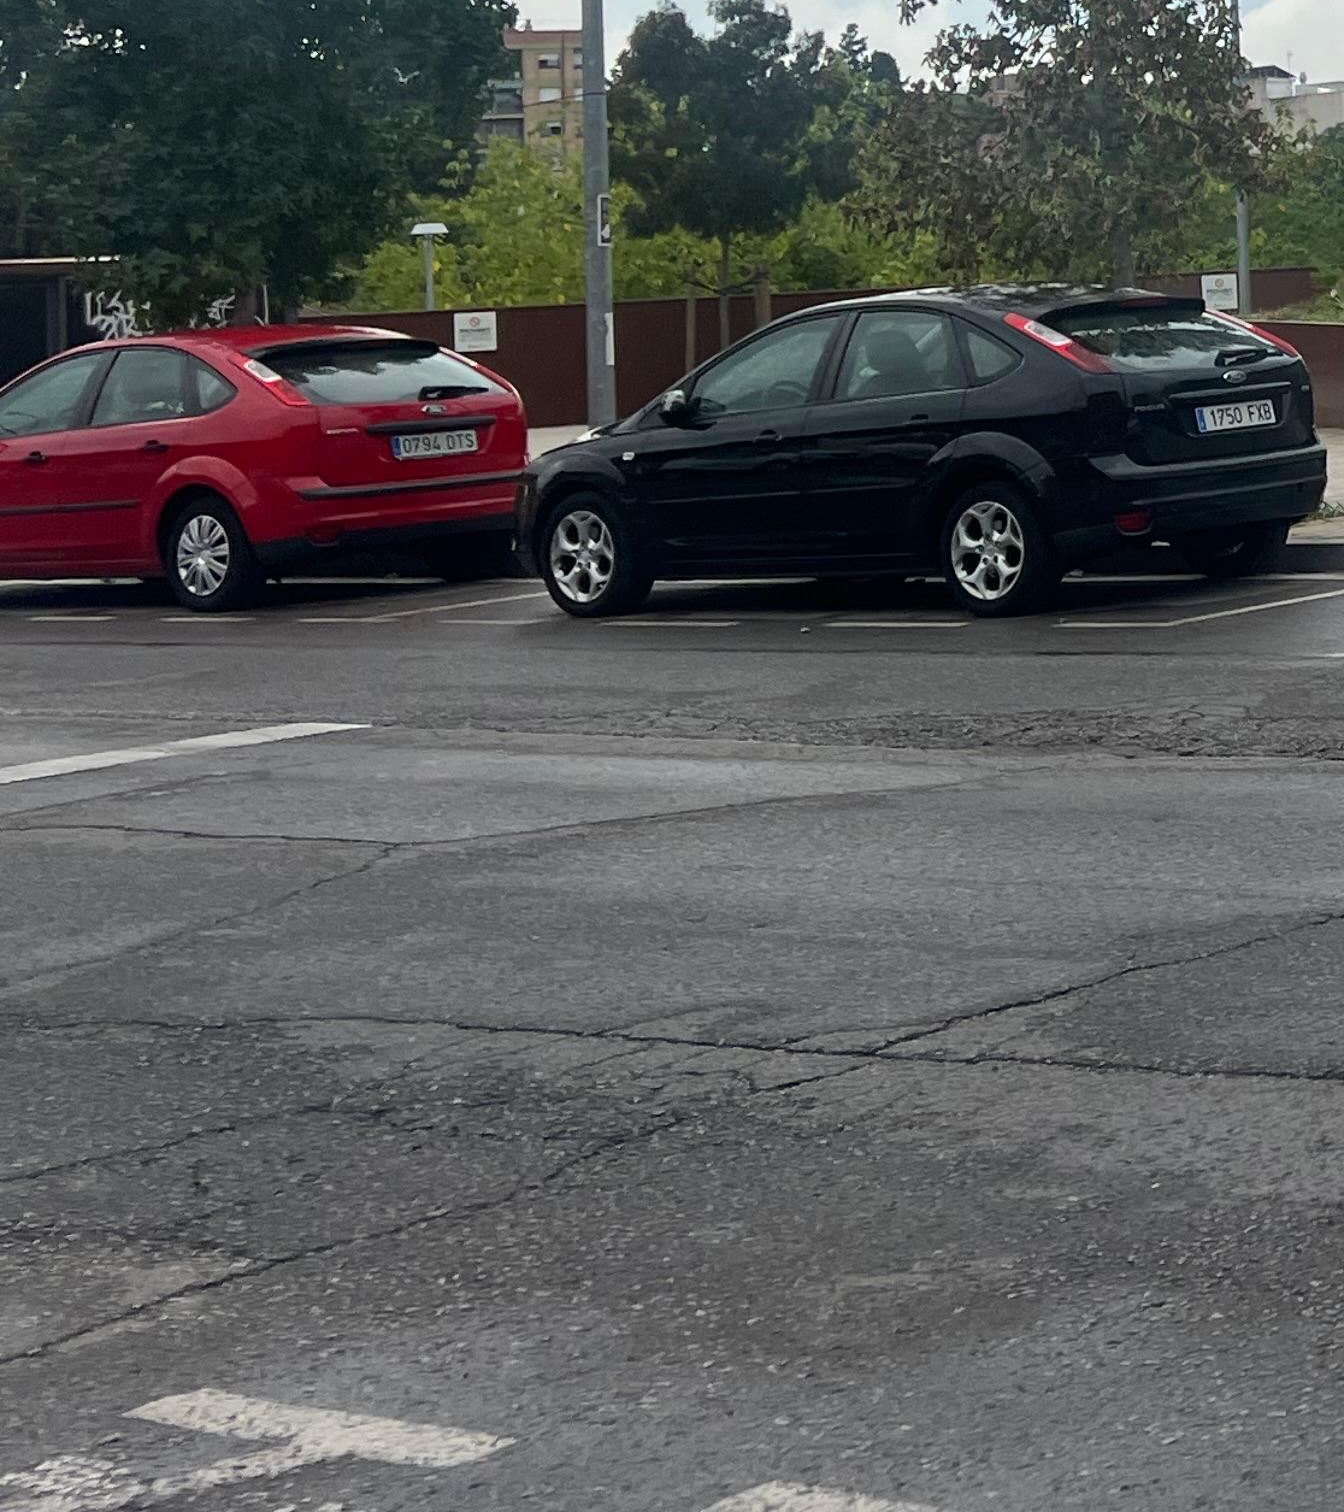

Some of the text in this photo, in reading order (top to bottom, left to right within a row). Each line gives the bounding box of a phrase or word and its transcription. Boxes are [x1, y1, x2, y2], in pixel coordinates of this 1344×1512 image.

[1210, 403, 1272, 427] 1750 FXB
[402, 433, 475, 454] 0794 DTS
